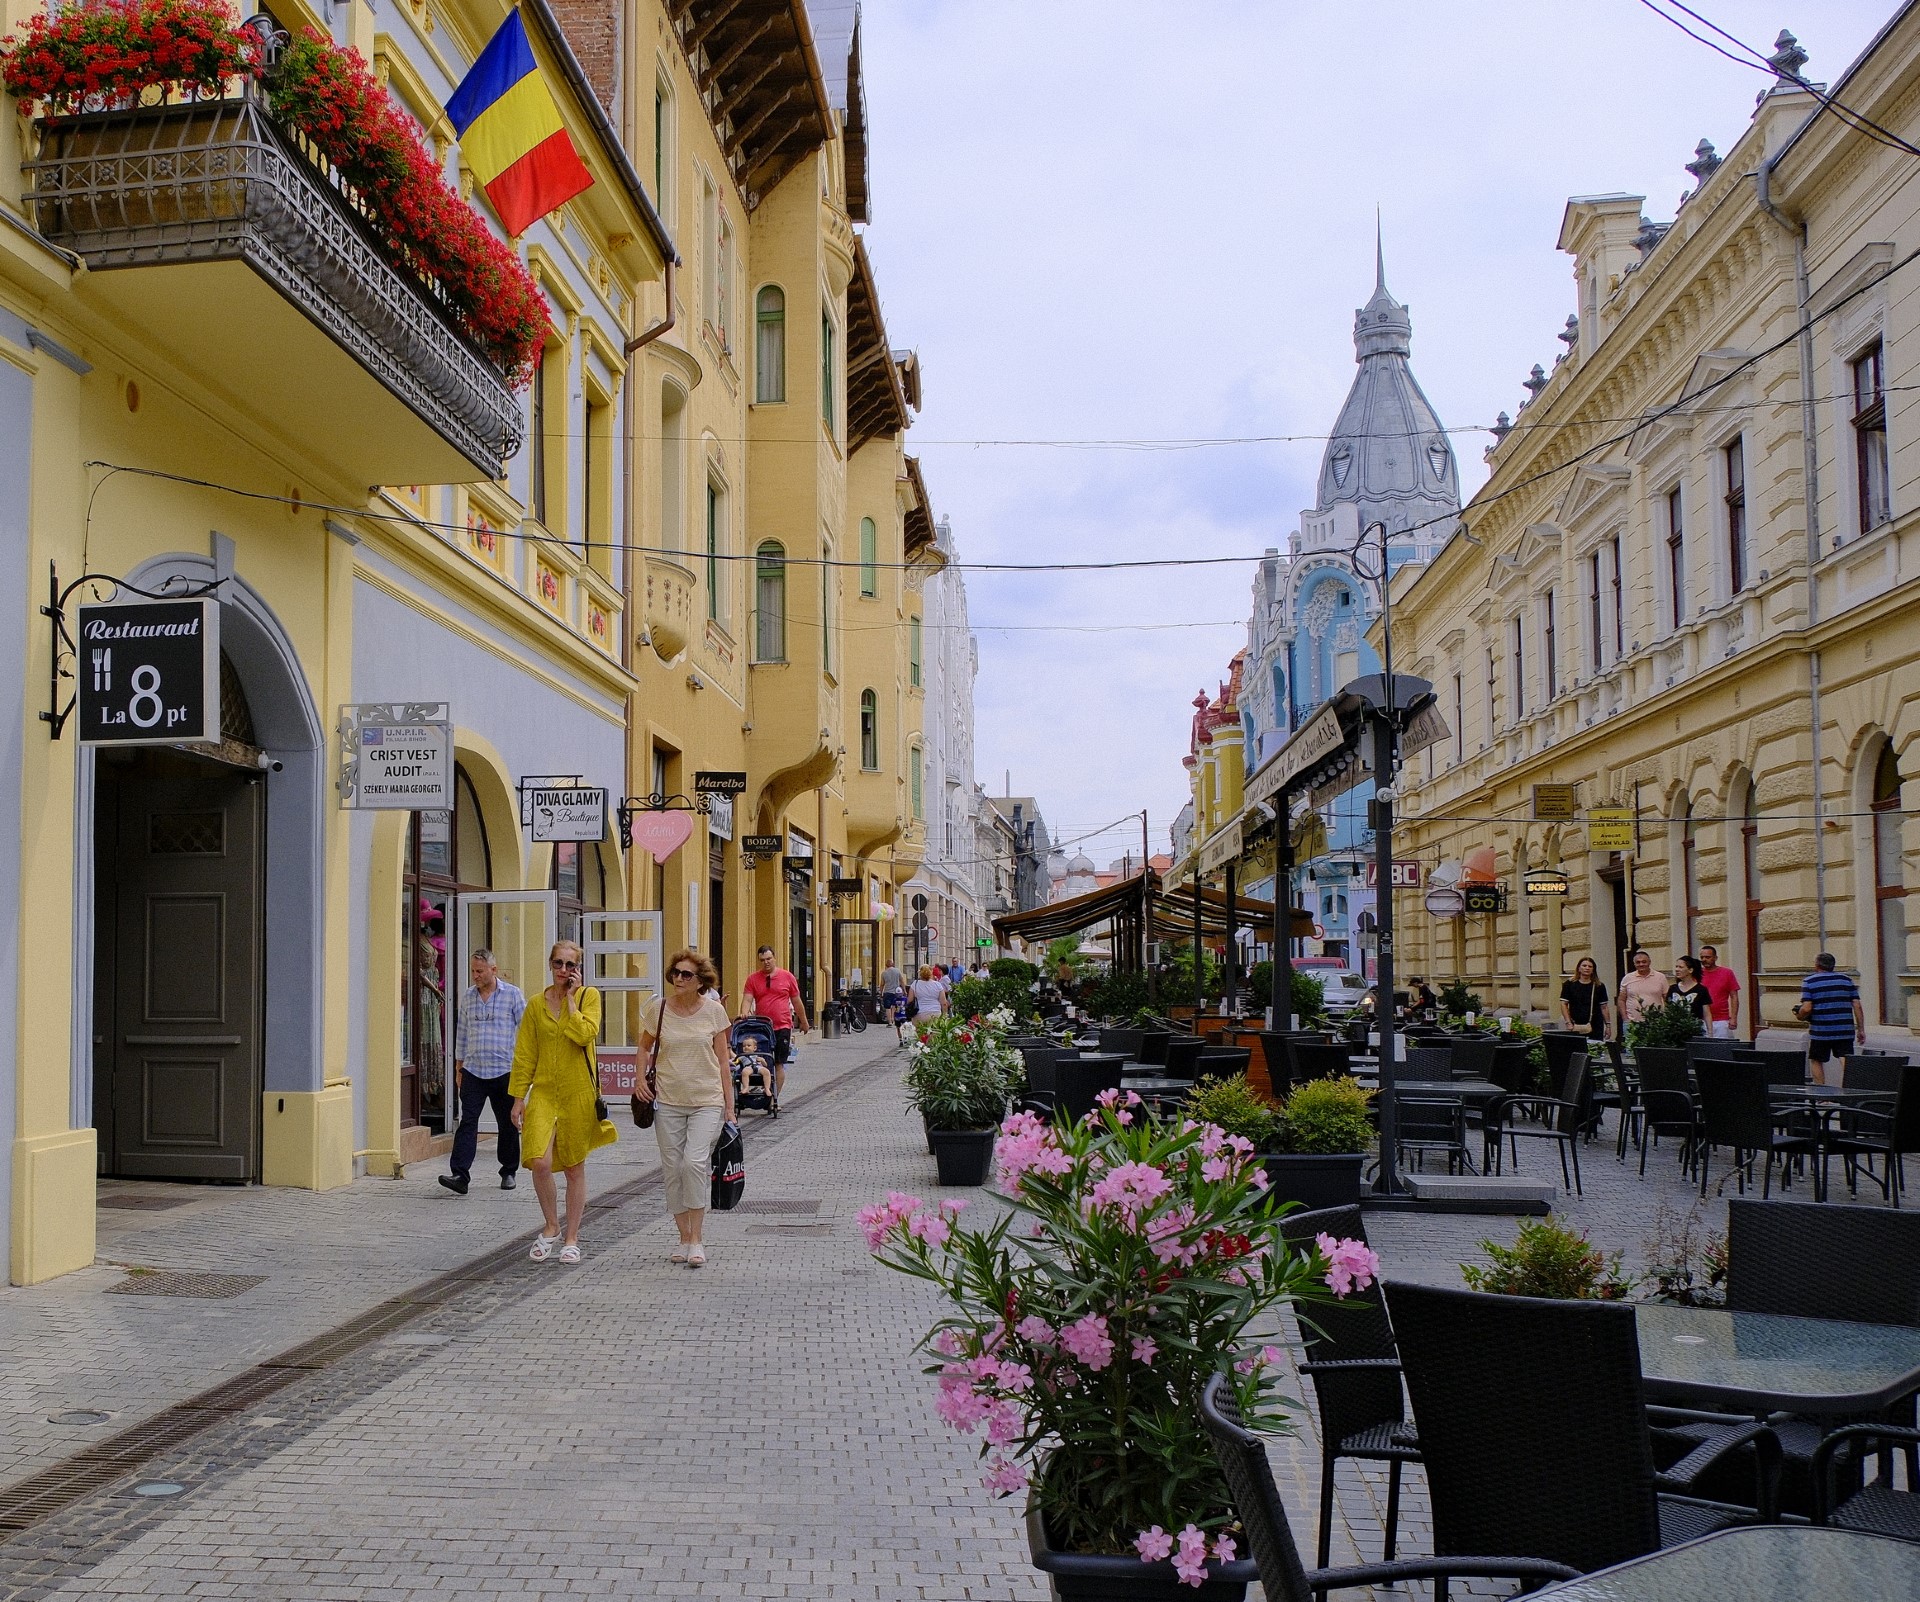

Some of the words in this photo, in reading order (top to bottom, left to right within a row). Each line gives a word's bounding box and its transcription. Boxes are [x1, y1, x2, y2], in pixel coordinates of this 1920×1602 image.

[84, 617, 199, 640] Restaurant
[386, 728, 427, 737] U.N.P.I.R.
[370, 749, 404, 761] CRIST
[406, 749, 437, 761] VEST
[384, 765, 422, 777] AUDIT
[697, 776, 745, 788] Marelbo
[363, 783, 388, 794] SZÉKELY
[389, 784, 410, 794] MARIA
[410, 784, 442, 794] GEORGETA
[536, 792, 561, 806] DIVA
[562, 792, 600, 806] GLAMY
[557, 808, 600, 826] Boutique
[746, 838, 778, 846] BODEA
[1527, 882, 1567, 892] BORING
